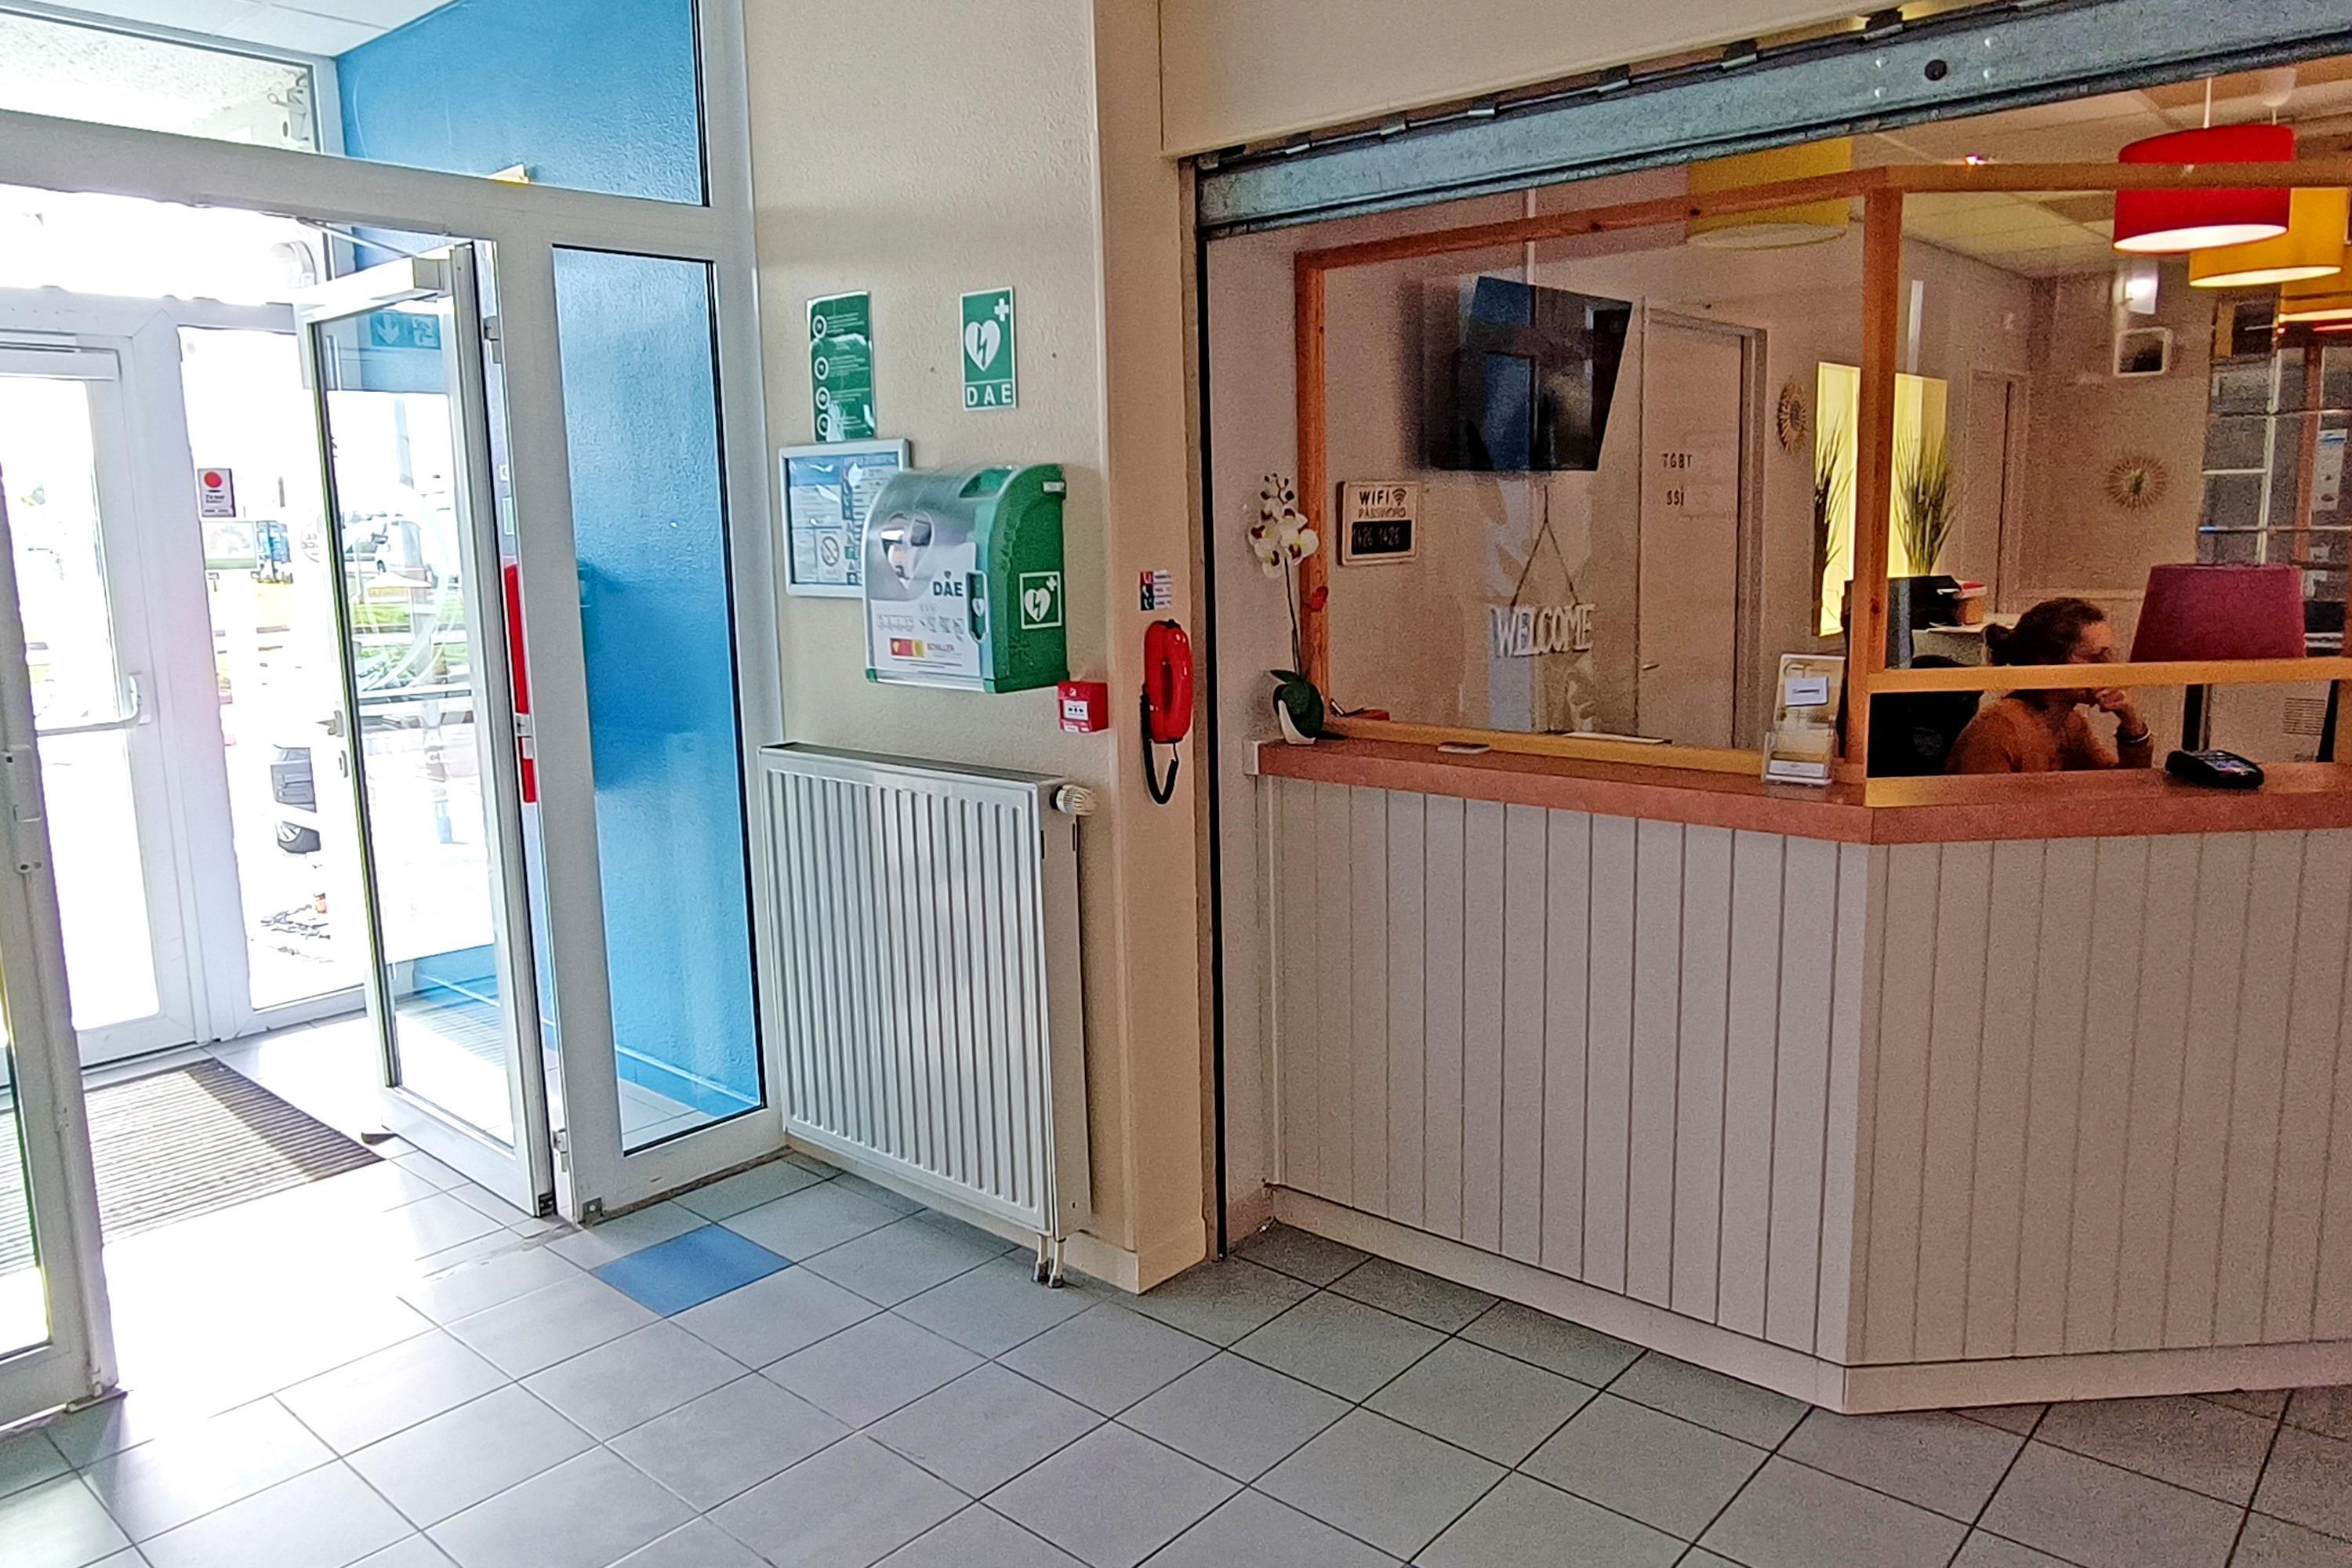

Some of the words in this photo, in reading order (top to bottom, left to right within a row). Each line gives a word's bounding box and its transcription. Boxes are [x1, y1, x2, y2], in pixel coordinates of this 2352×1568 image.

[967, 383, 1012, 406] DAE
[1661, 452, 1693, 468] TGBT
[1359, 488, 1390, 505] WIFI
[933, 580, 964, 597] DAE
[1488, 603, 1595, 658] WELCOME
